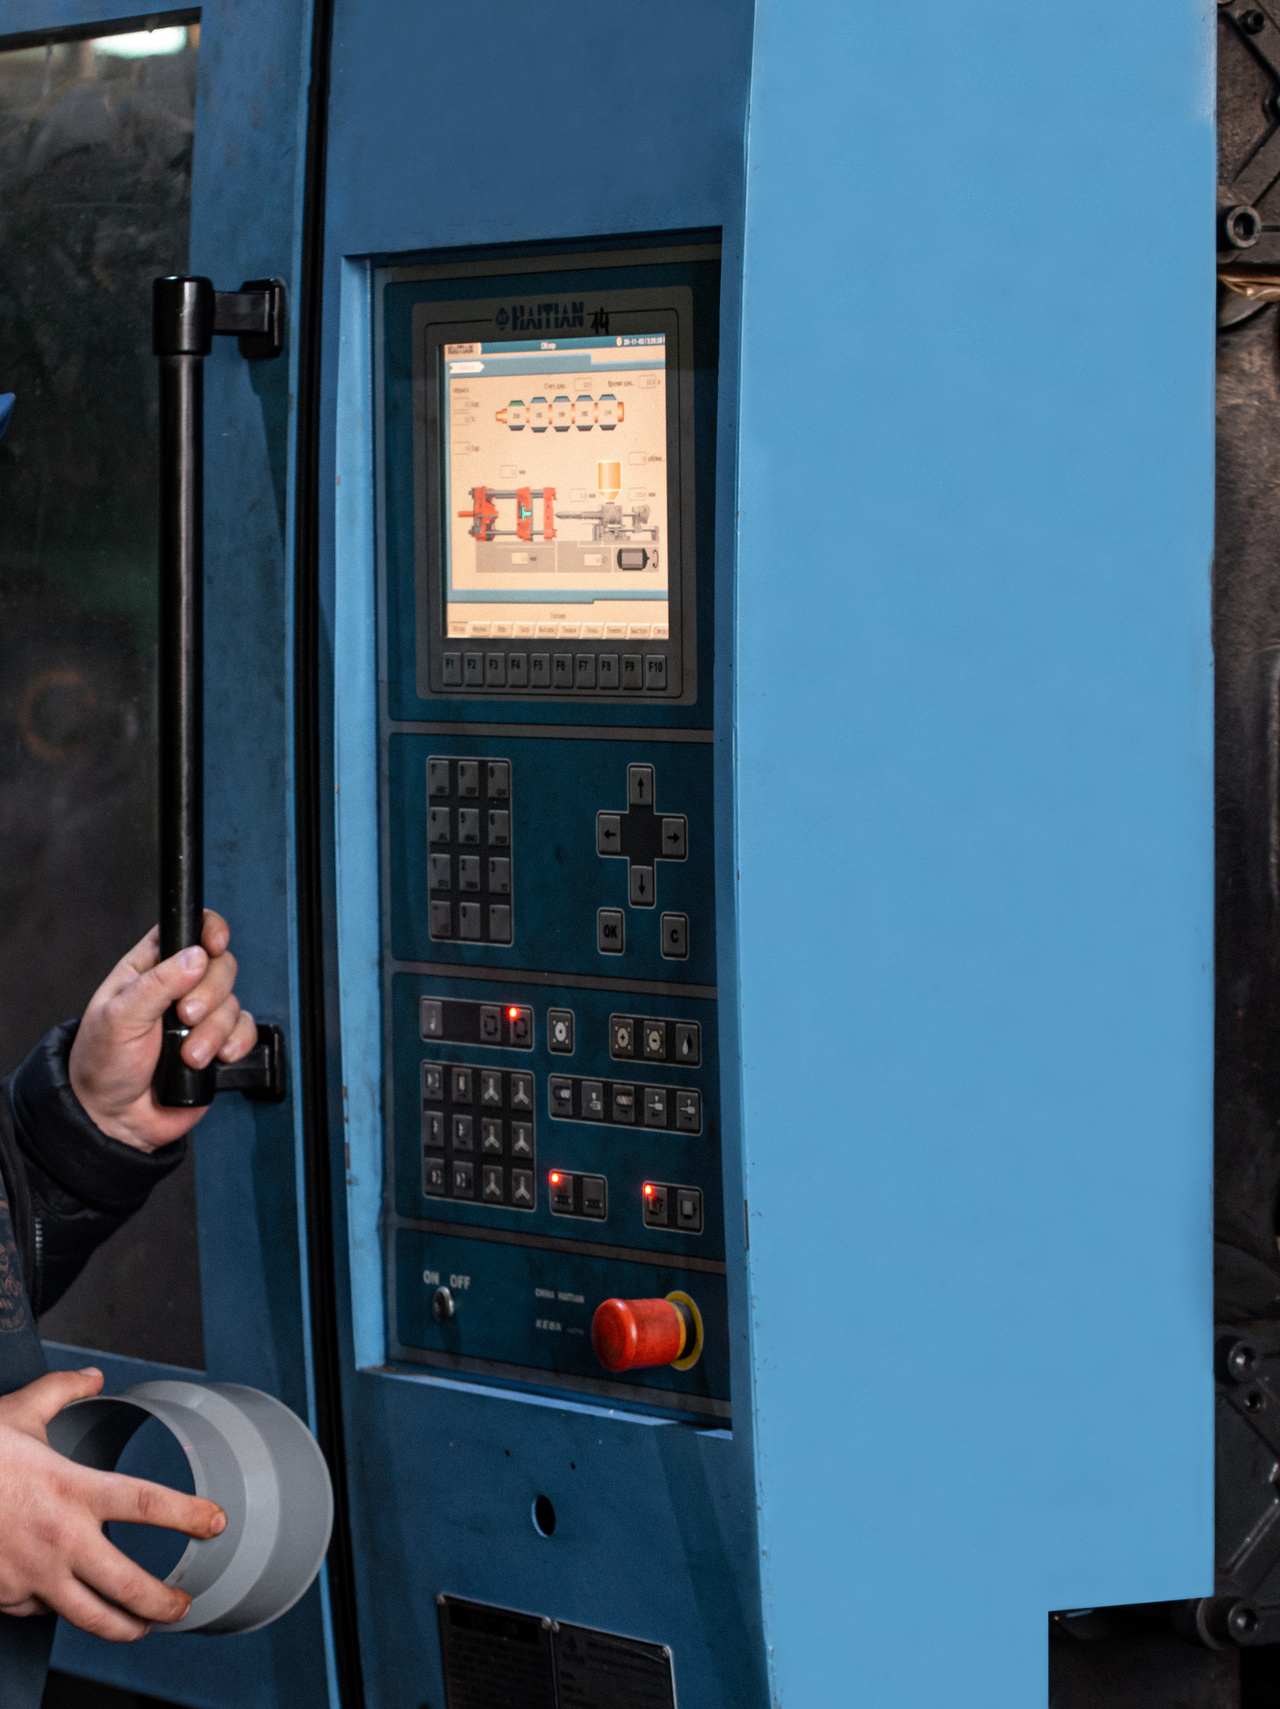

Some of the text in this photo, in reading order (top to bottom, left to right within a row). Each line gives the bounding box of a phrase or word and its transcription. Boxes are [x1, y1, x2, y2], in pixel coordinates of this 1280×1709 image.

[511, 301, 584, 331] HAITIAN
[446, 659, 454, 669] F1
[467, 659, 477, 670] F2
[489, 659, 498, 670] F3
[511, 660, 520, 670] F4
[533, 660, 543, 671] F5
[556, 660, 566, 671] F6
[578, 661, 588, 671] F7
[601, 661, 611, 672] F8
[624, 661, 635, 672] F9
[648, 661, 663, 673] F10
[460, 859, 466, 871] 2
[603, 924, 618, 939] OK
[670, 929, 678, 943] C
[423, 1269, 471, 1290] ON OFF
